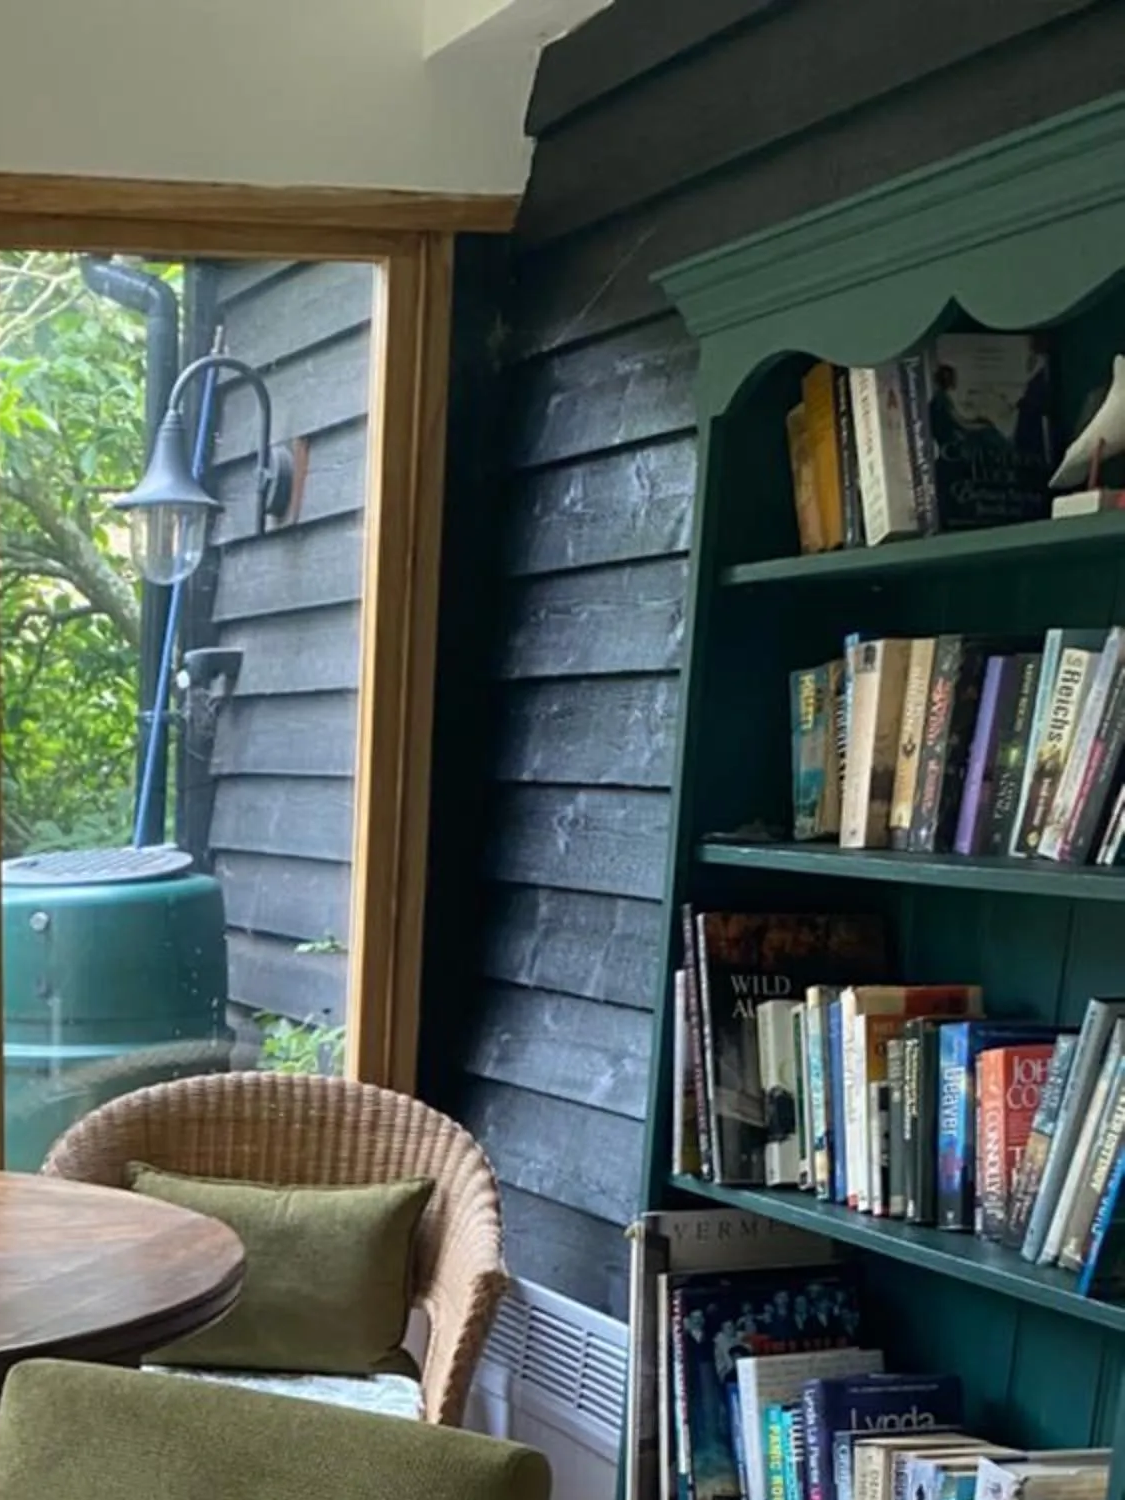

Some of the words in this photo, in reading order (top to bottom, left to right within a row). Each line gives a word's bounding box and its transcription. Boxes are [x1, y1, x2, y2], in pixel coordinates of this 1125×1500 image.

[1046, 669, 1081, 742] Reichs
[730, 973, 792, 996] WILD
[1012, 1056, 1050, 1085] JOH
[672, 1219, 782, 1243] VERME
[850, 1405, 935, 1432] Lynda
[768, 1424, 784, 1468] PANIC
